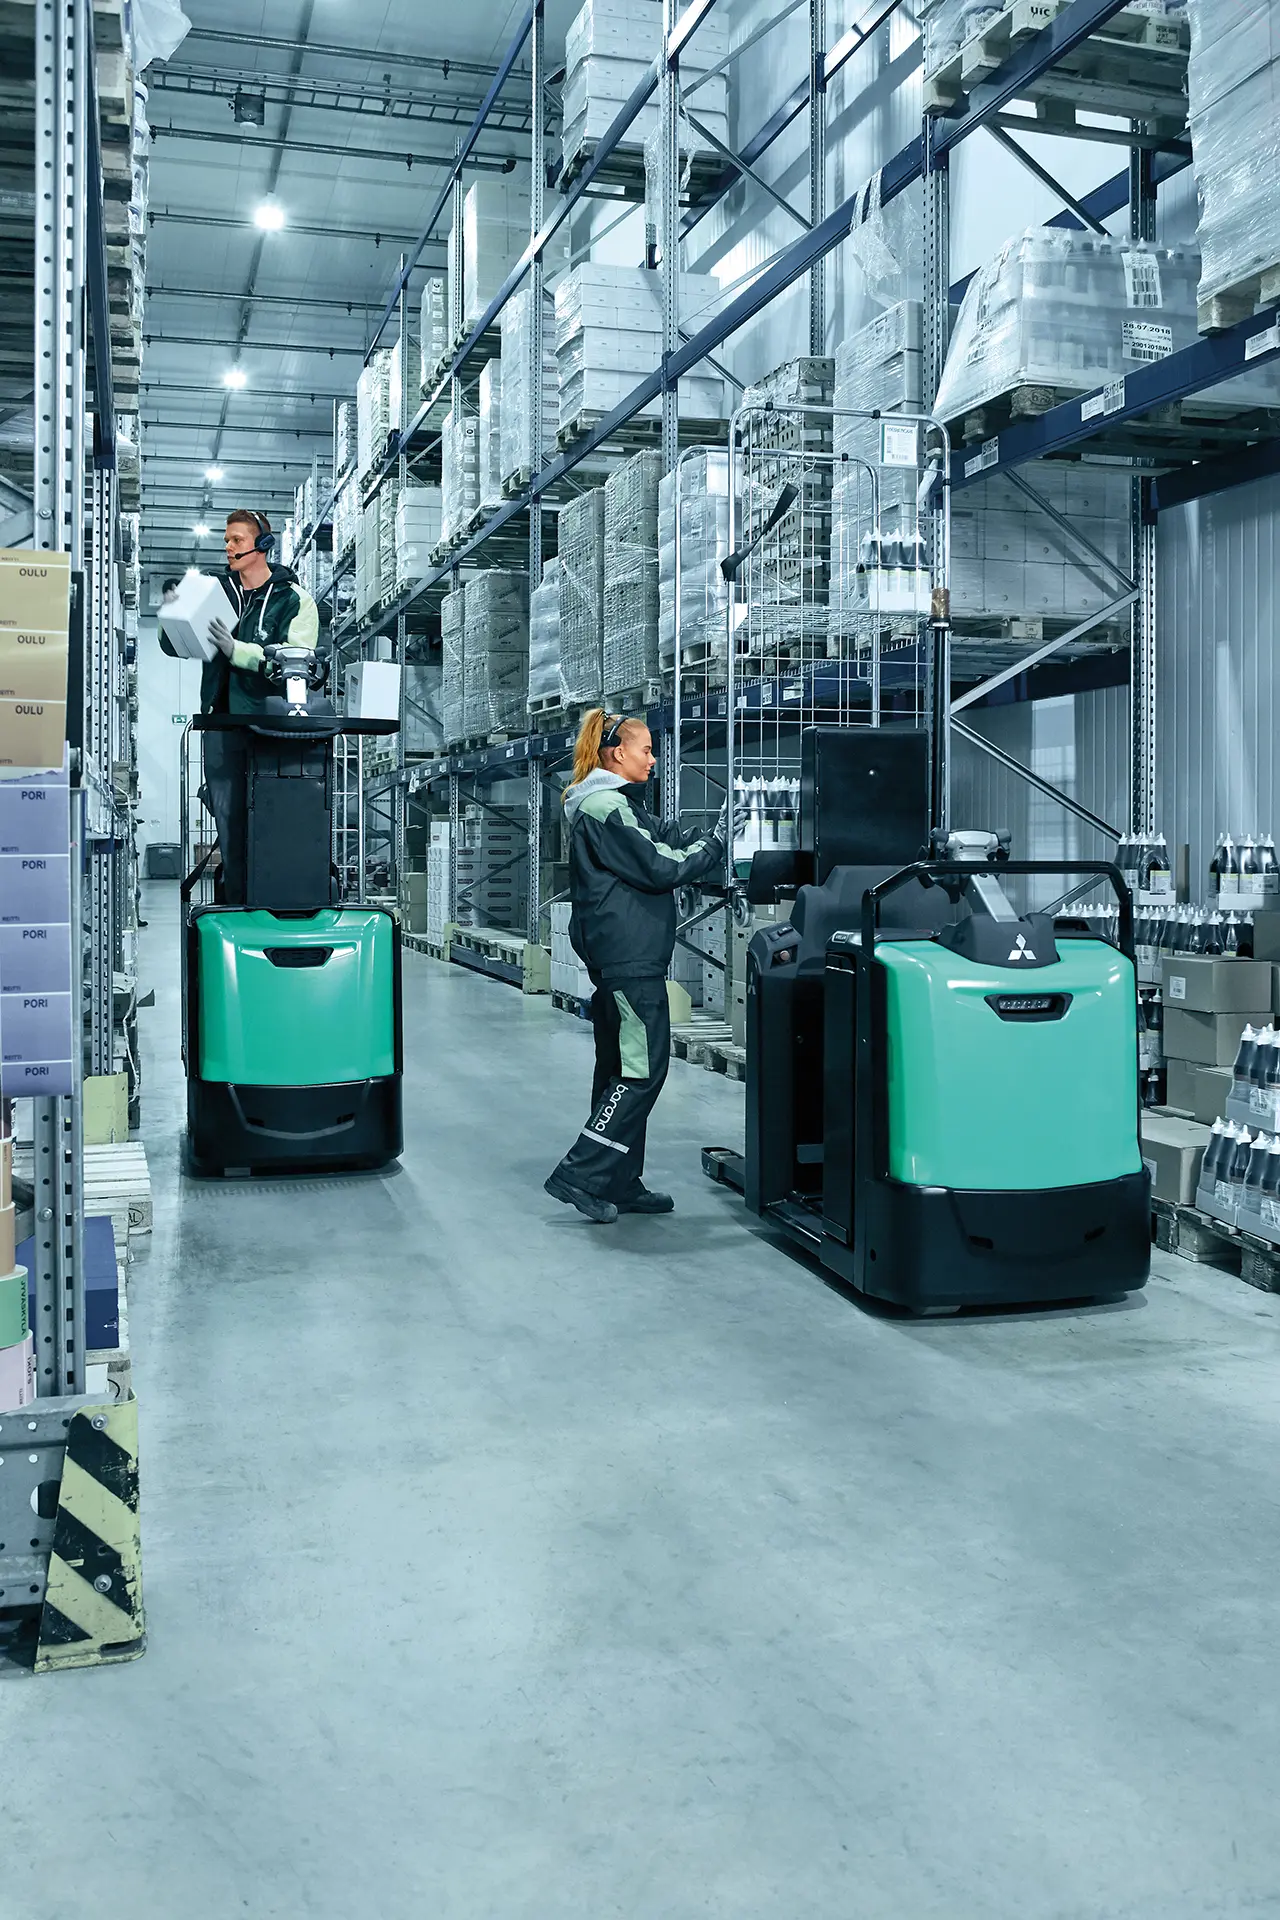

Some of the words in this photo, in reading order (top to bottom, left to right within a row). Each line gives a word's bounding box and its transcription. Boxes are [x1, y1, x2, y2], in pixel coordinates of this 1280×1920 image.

[19, 567, 47, 578] OULU
[17, 634, 46, 645] OULU
[15, 704, 43, 716] OULU
[21, 790, 46, 801] PORI
[21, 859, 47, 870] PORI
[22, 929, 47, 940] PORI
[23, 998, 48, 1009] PORI
[25, 1066, 49, 1077] PORI
